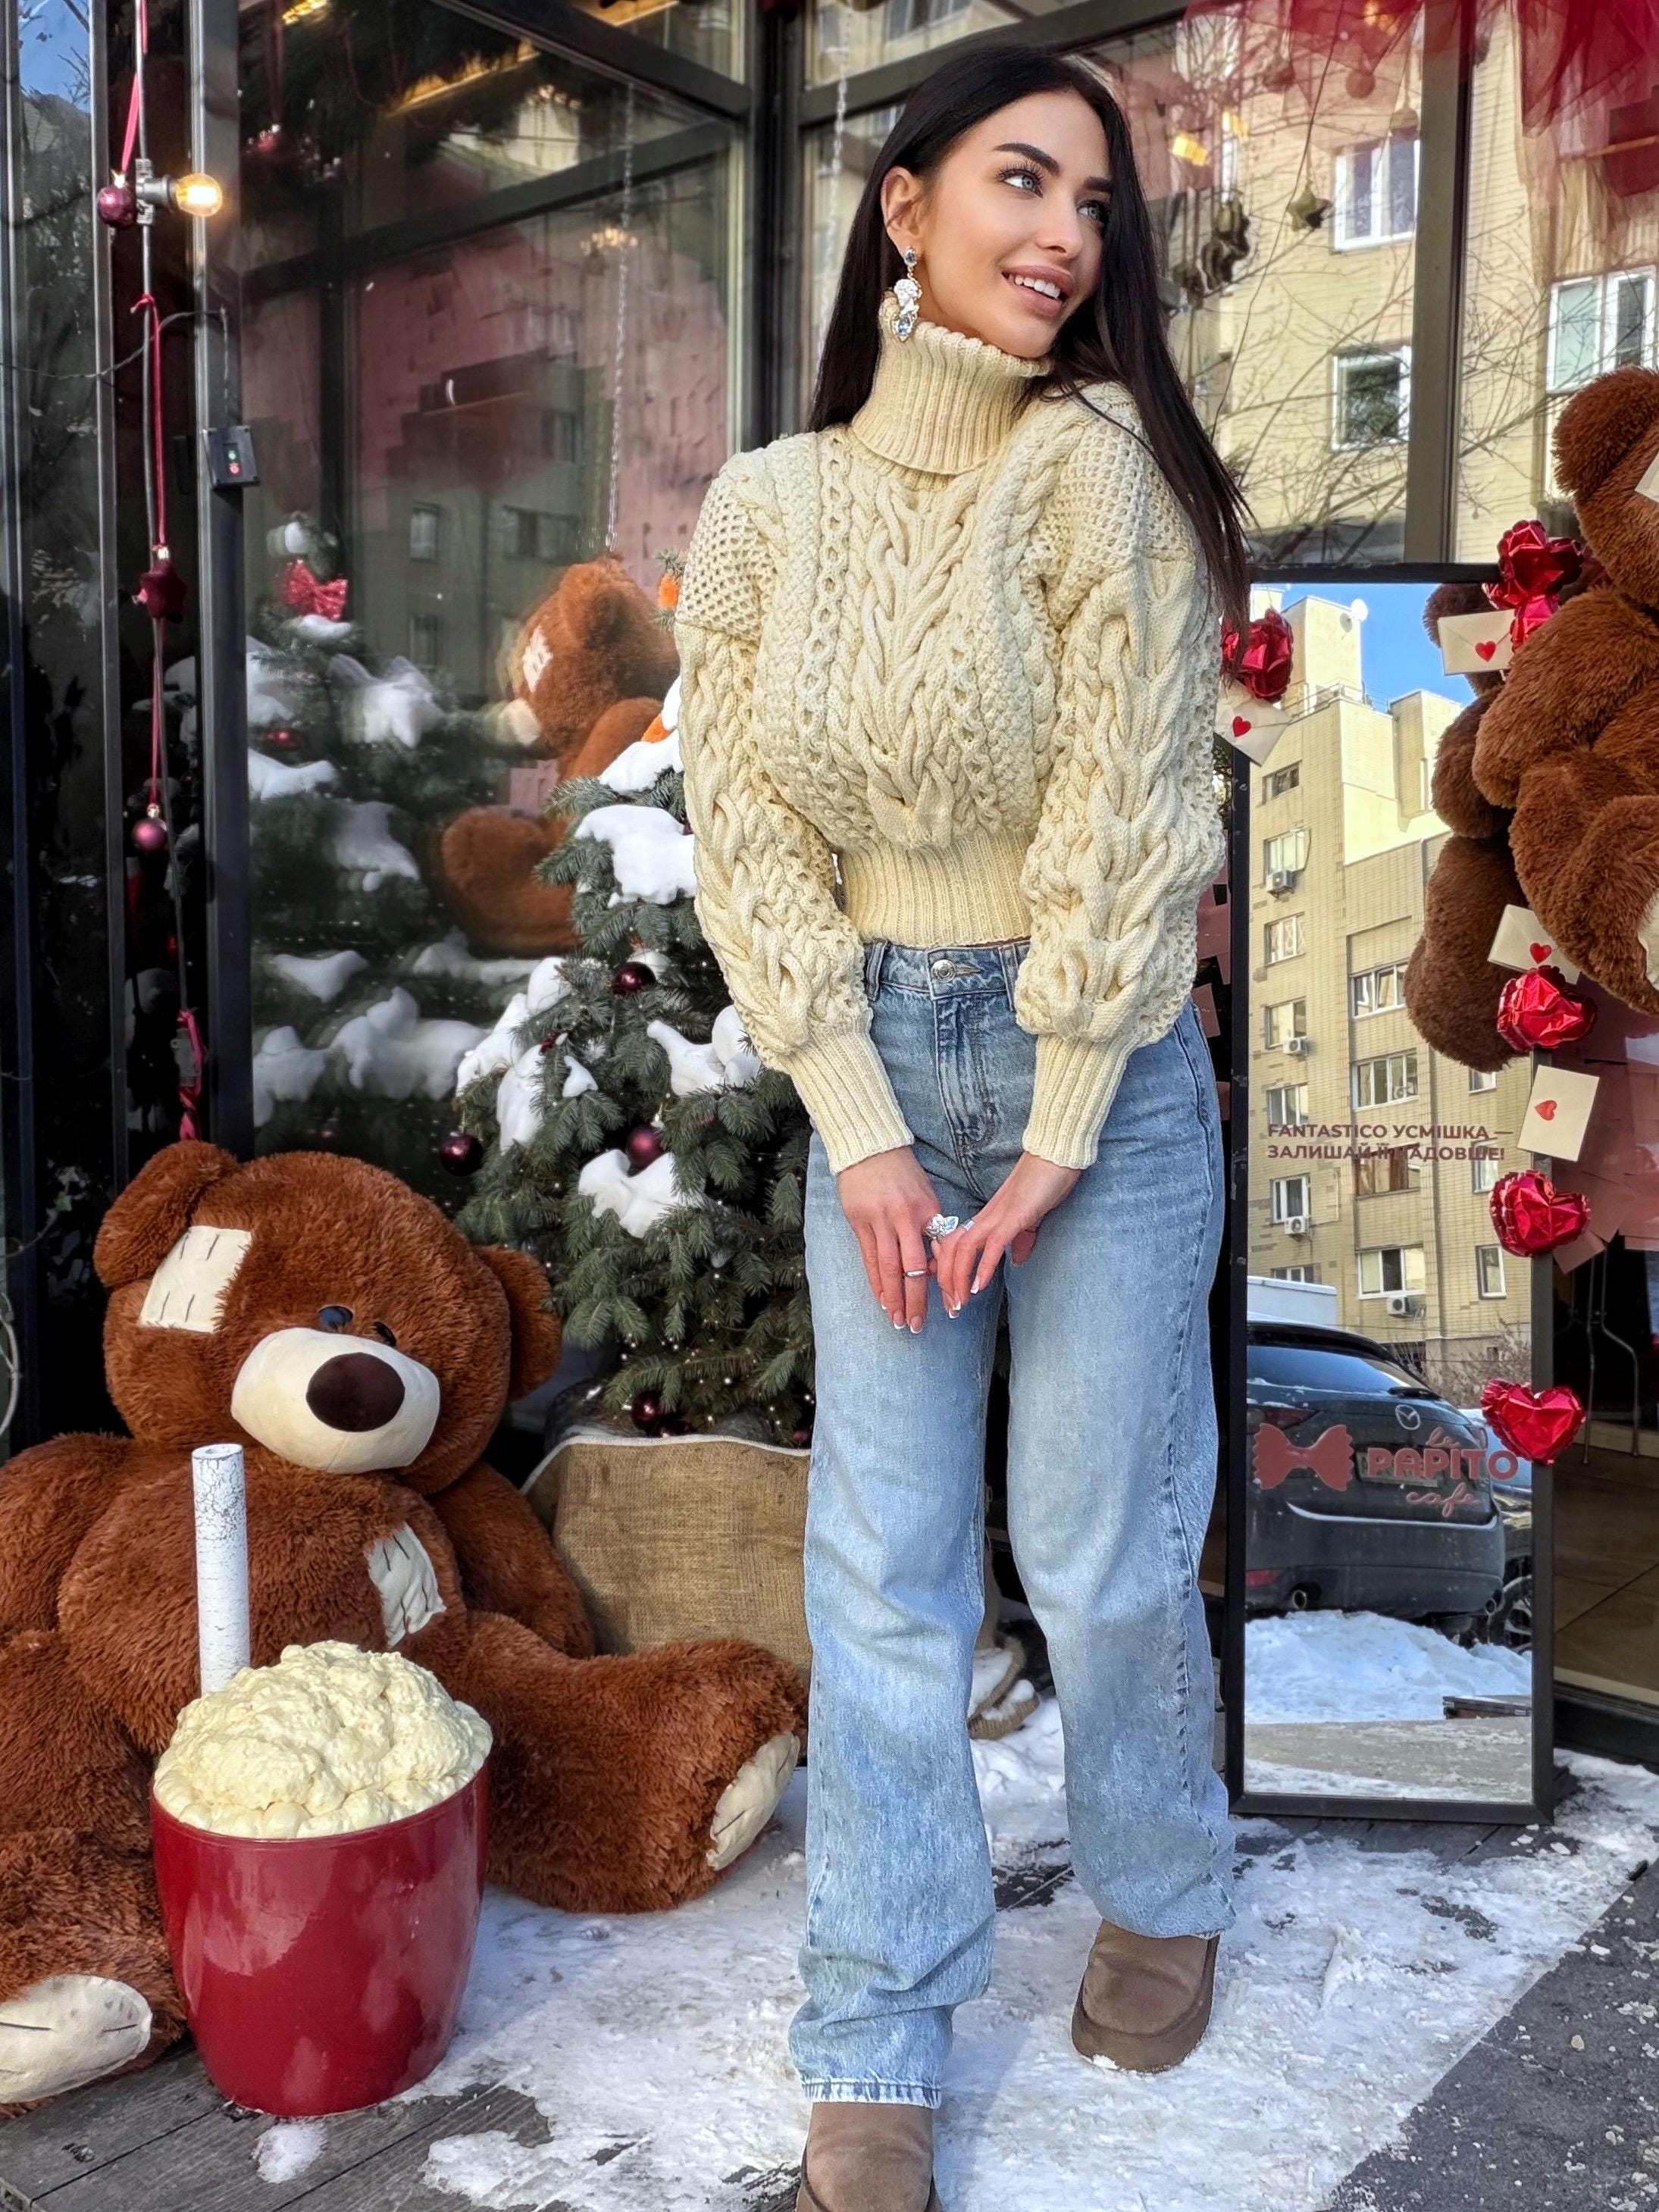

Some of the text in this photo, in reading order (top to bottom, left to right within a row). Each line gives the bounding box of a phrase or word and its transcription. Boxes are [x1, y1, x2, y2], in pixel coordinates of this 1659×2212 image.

[1268, 1124, 1388, 1138] FANTASTICO
[1392, 1125, 1489, 1139] УСМІШКА
[1267, 1143, 1371, 1159] ЗАЛИШАЙ
[1367, 1448, 1519, 1480] PAPITO
[1406, 1482, 1480, 1518] cafe
